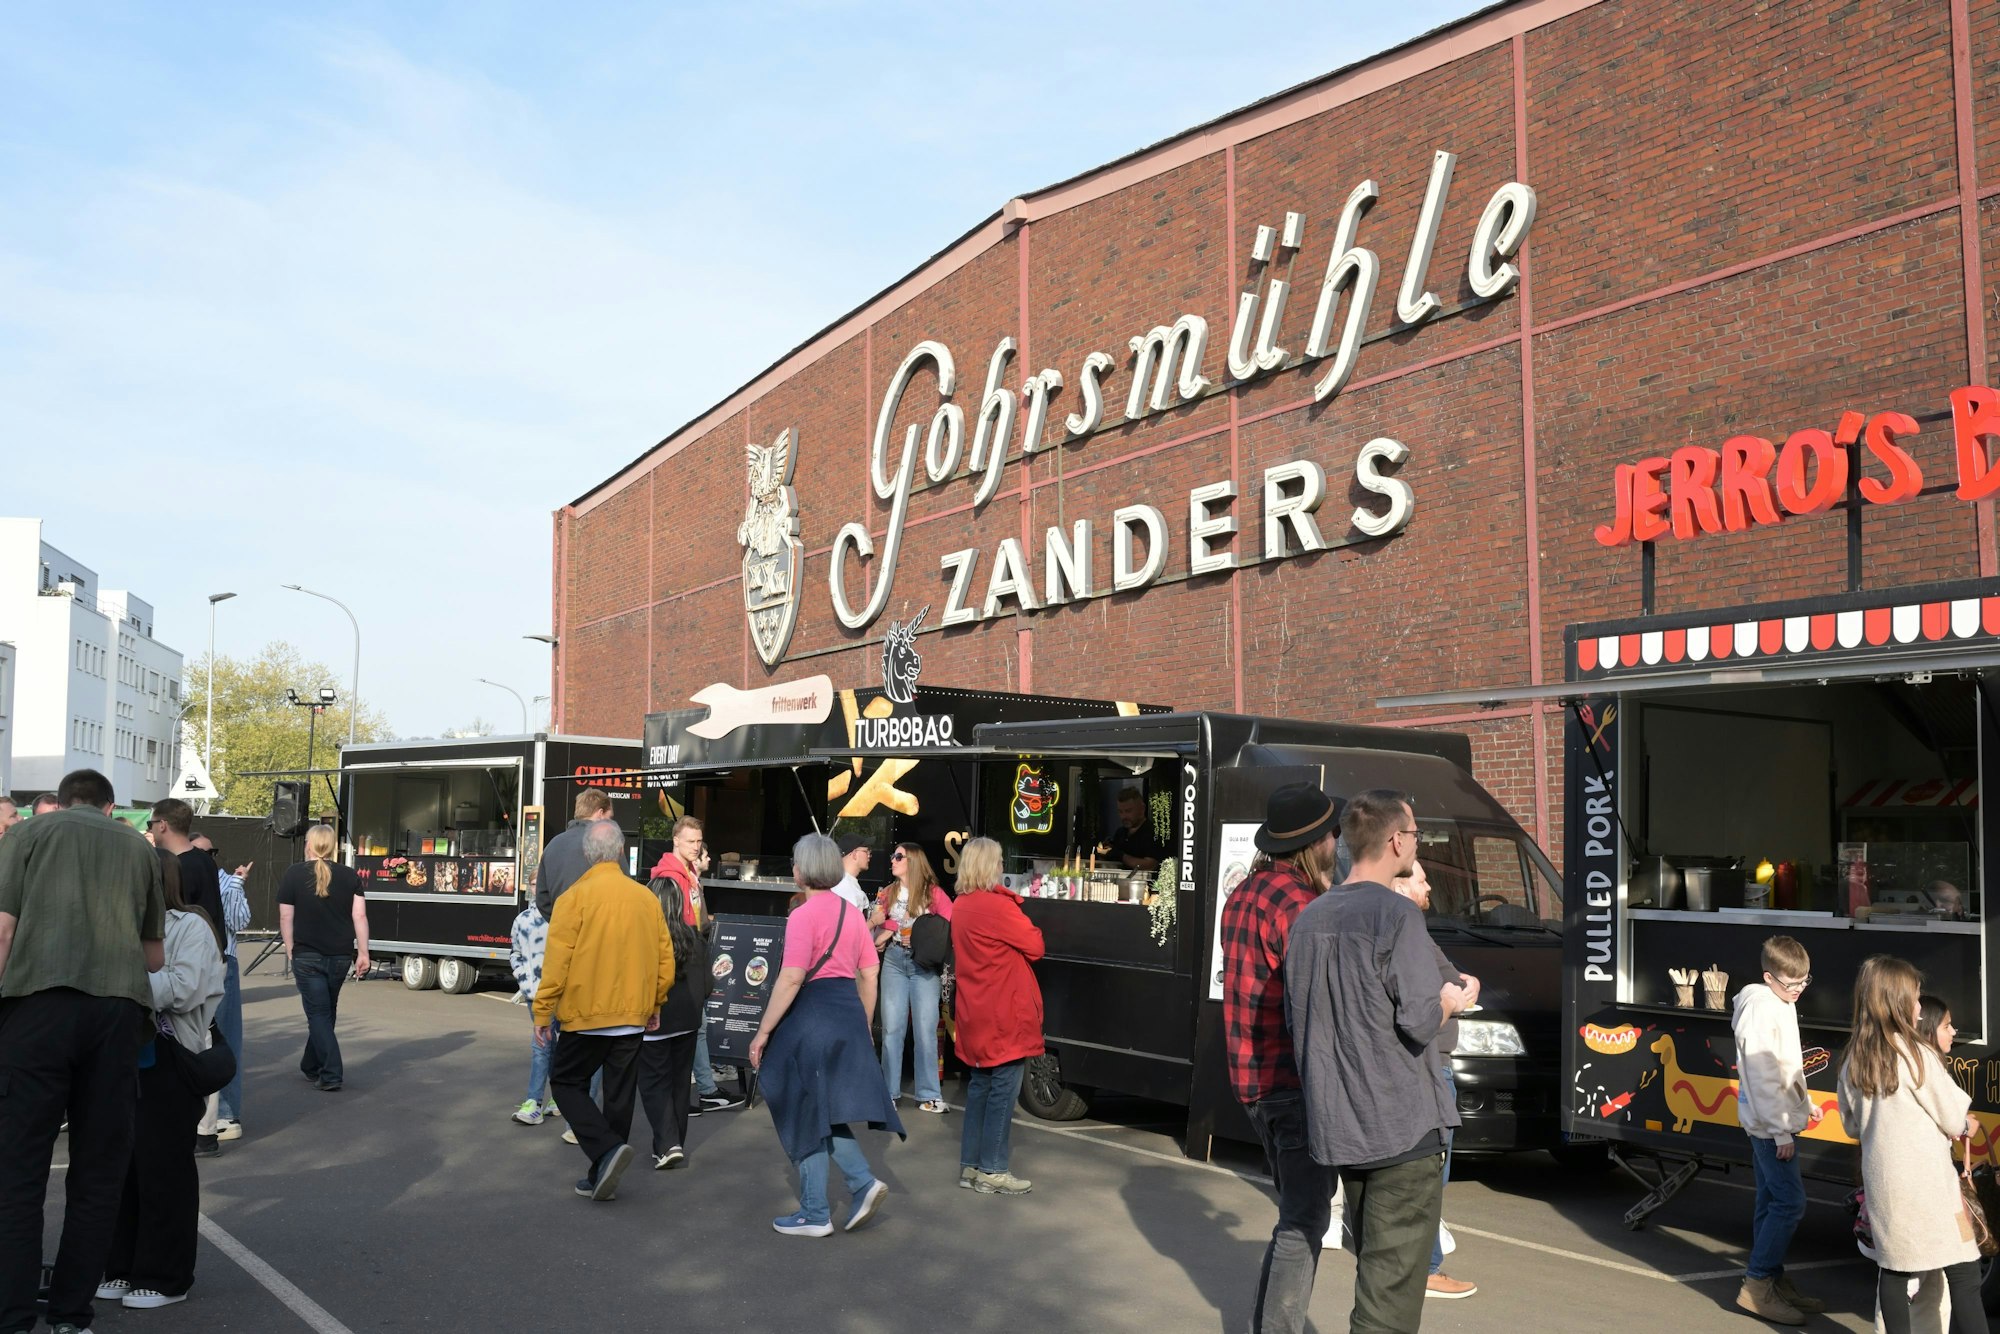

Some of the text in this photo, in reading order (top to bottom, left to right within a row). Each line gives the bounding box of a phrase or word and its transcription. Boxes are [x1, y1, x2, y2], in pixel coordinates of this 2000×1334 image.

[830, 149, 1538, 630] Gohrsmühle
[1594, 410, 1923, 547] JERRO'S
[940, 437, 1415, 627] ZANDERS
[772, 692, 817, 714] frittenwerk
[855, 715, 953, 748] TURBOBAO
[650, 744, 680, 765] EVERY DAY
[1182, 784, 1196, 881] ORDER
[1584, 770, 1614, 981] PULLED PORK
[1181, 882, 1194, 890] HERE
